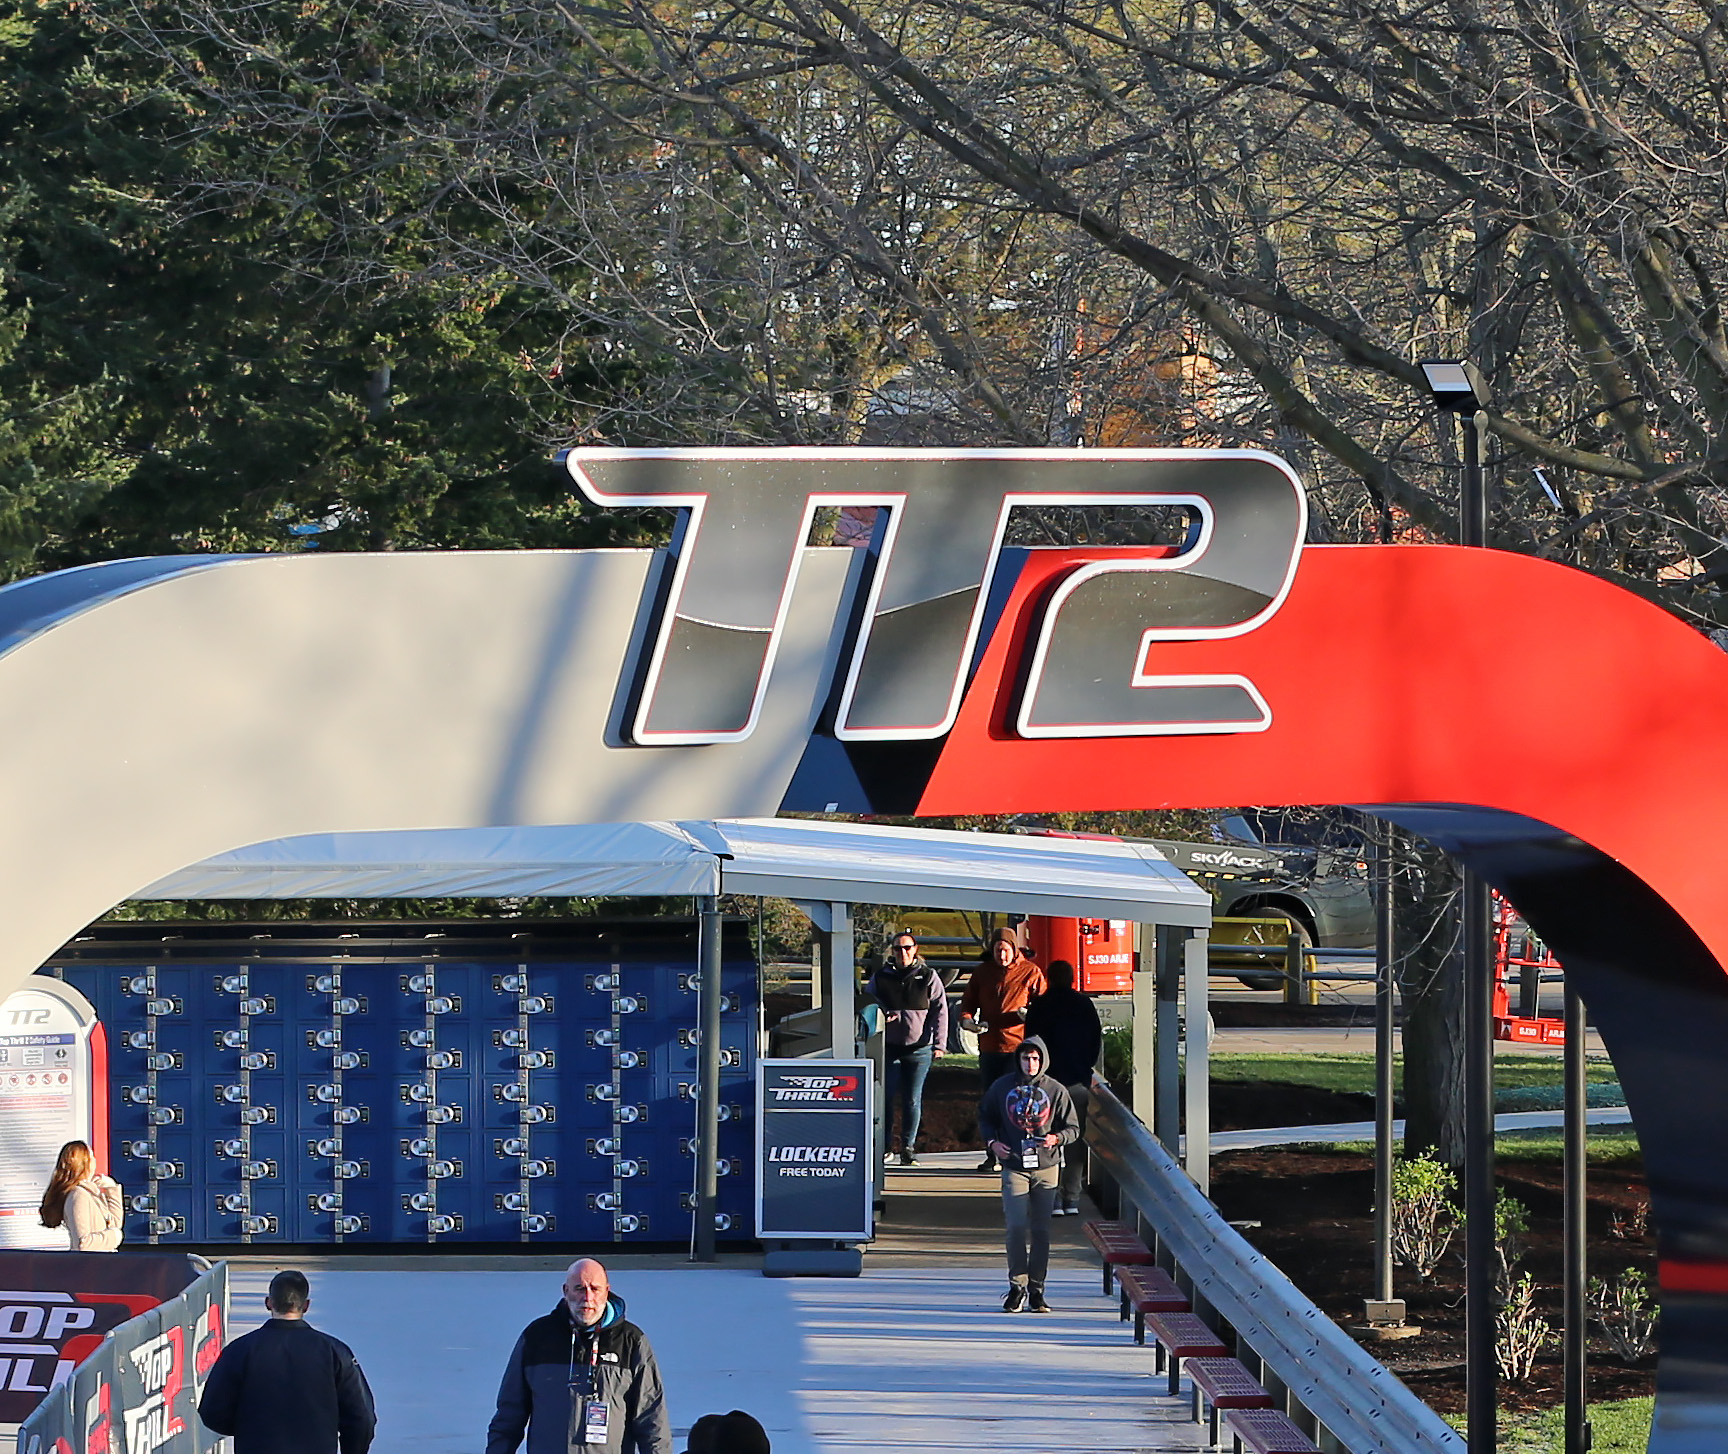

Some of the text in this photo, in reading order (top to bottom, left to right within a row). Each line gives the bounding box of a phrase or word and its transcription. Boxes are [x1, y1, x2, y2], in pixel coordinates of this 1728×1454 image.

[565, 446, 1309, 746] TT2
[1191, 850, 1264, 869] SKYJACK
[7, 1008, 52, 1026] TT2
[768, 1087, 838, 1101] THRILL
[779, 1075, 860, 1100] TOP 2
[768, 1146, 857, 1163] LOCKERS
[779, 1167, 846, 1178] FREE TODAY
